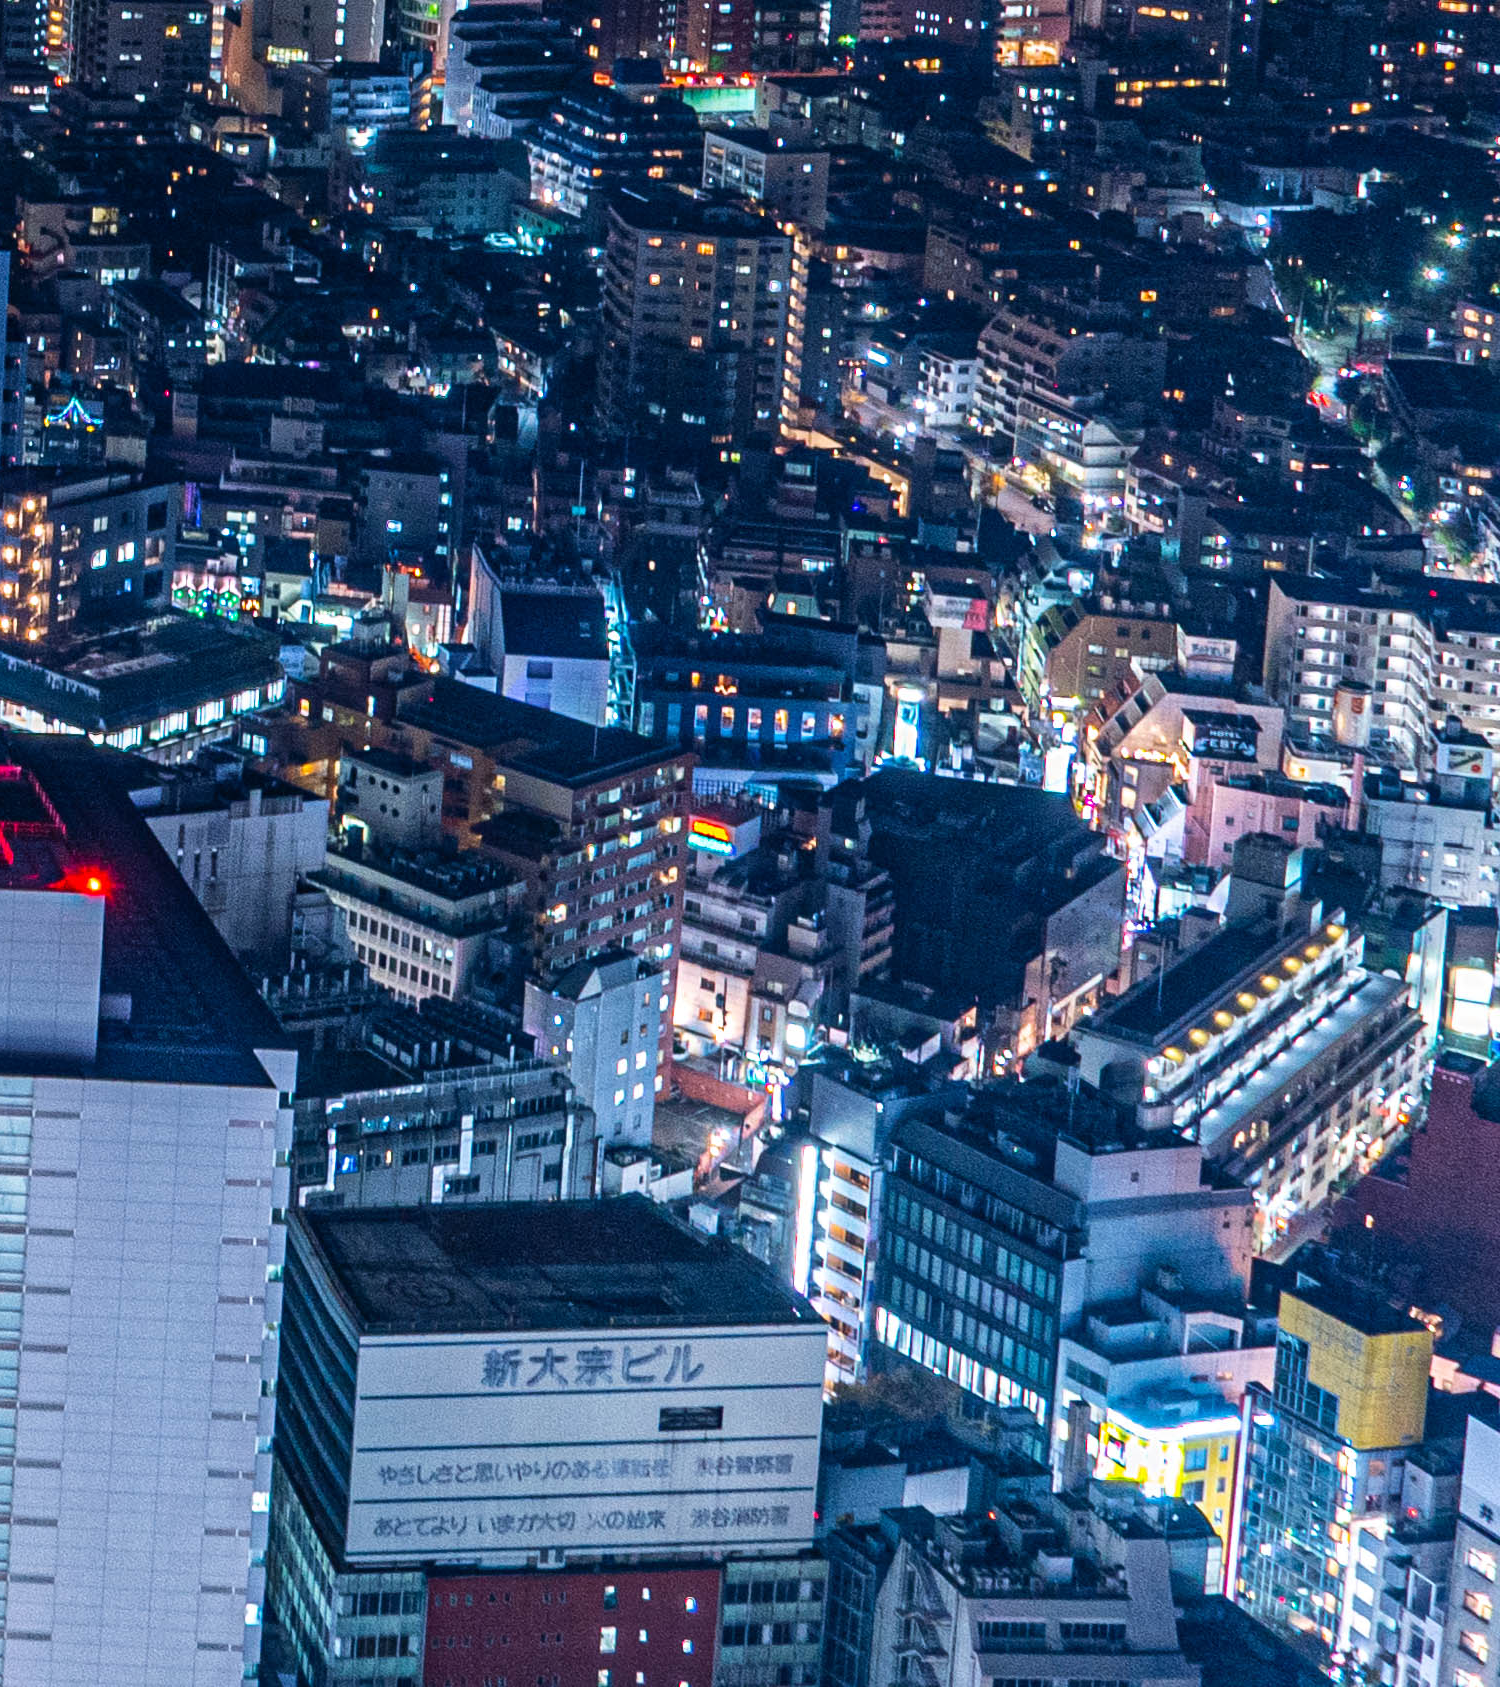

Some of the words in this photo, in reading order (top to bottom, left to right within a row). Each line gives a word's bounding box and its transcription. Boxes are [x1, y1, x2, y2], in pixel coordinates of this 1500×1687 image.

[1209, 729, 1242, 740] HOTEL
[481, 1344, 705, 1387] 新大宗ビル
[697, 1453, 795, 1476] 渋谷警察署
